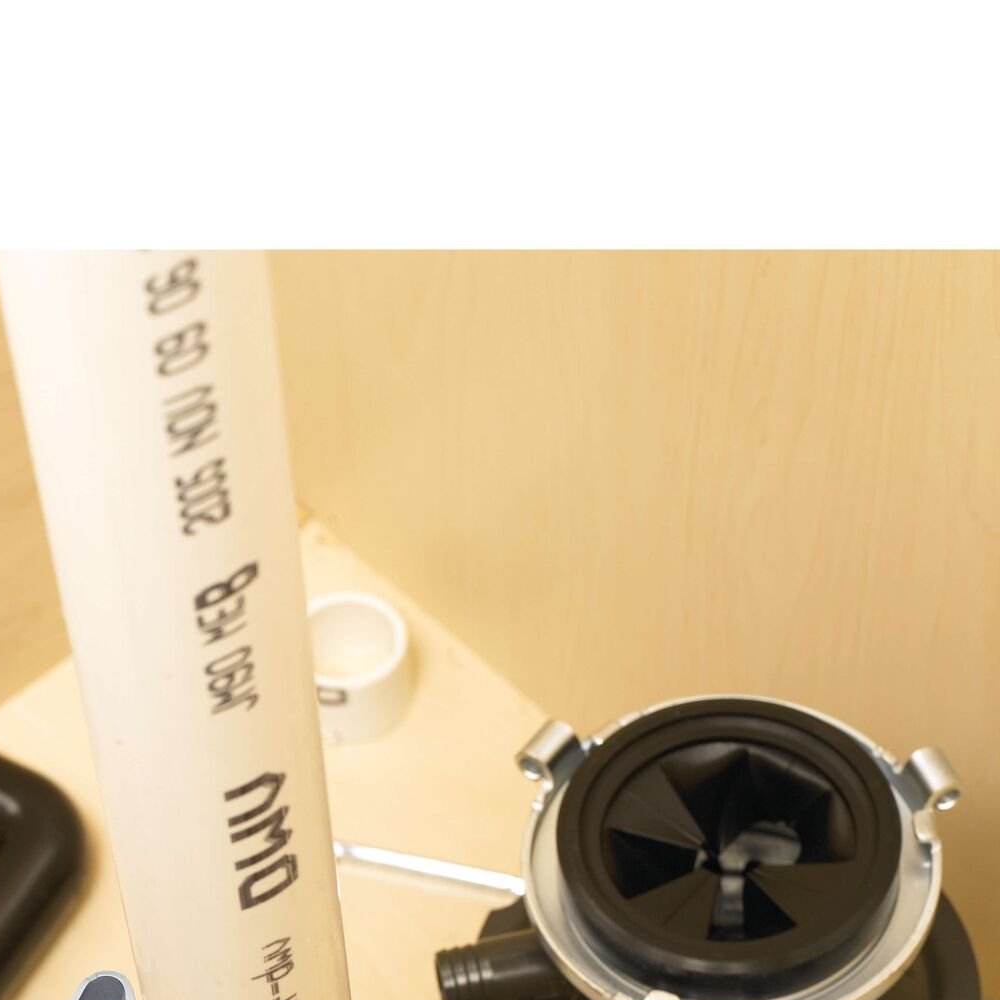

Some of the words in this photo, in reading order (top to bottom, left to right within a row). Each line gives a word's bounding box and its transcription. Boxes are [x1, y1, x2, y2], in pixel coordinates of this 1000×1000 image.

[143, 256, 202, 317] 06
[153, 320, 211, 378] 09
[161, 382, 221, 459] NOV
[174, 455, 231, 537] 2005
[223, 771, 299, 911] DWV
